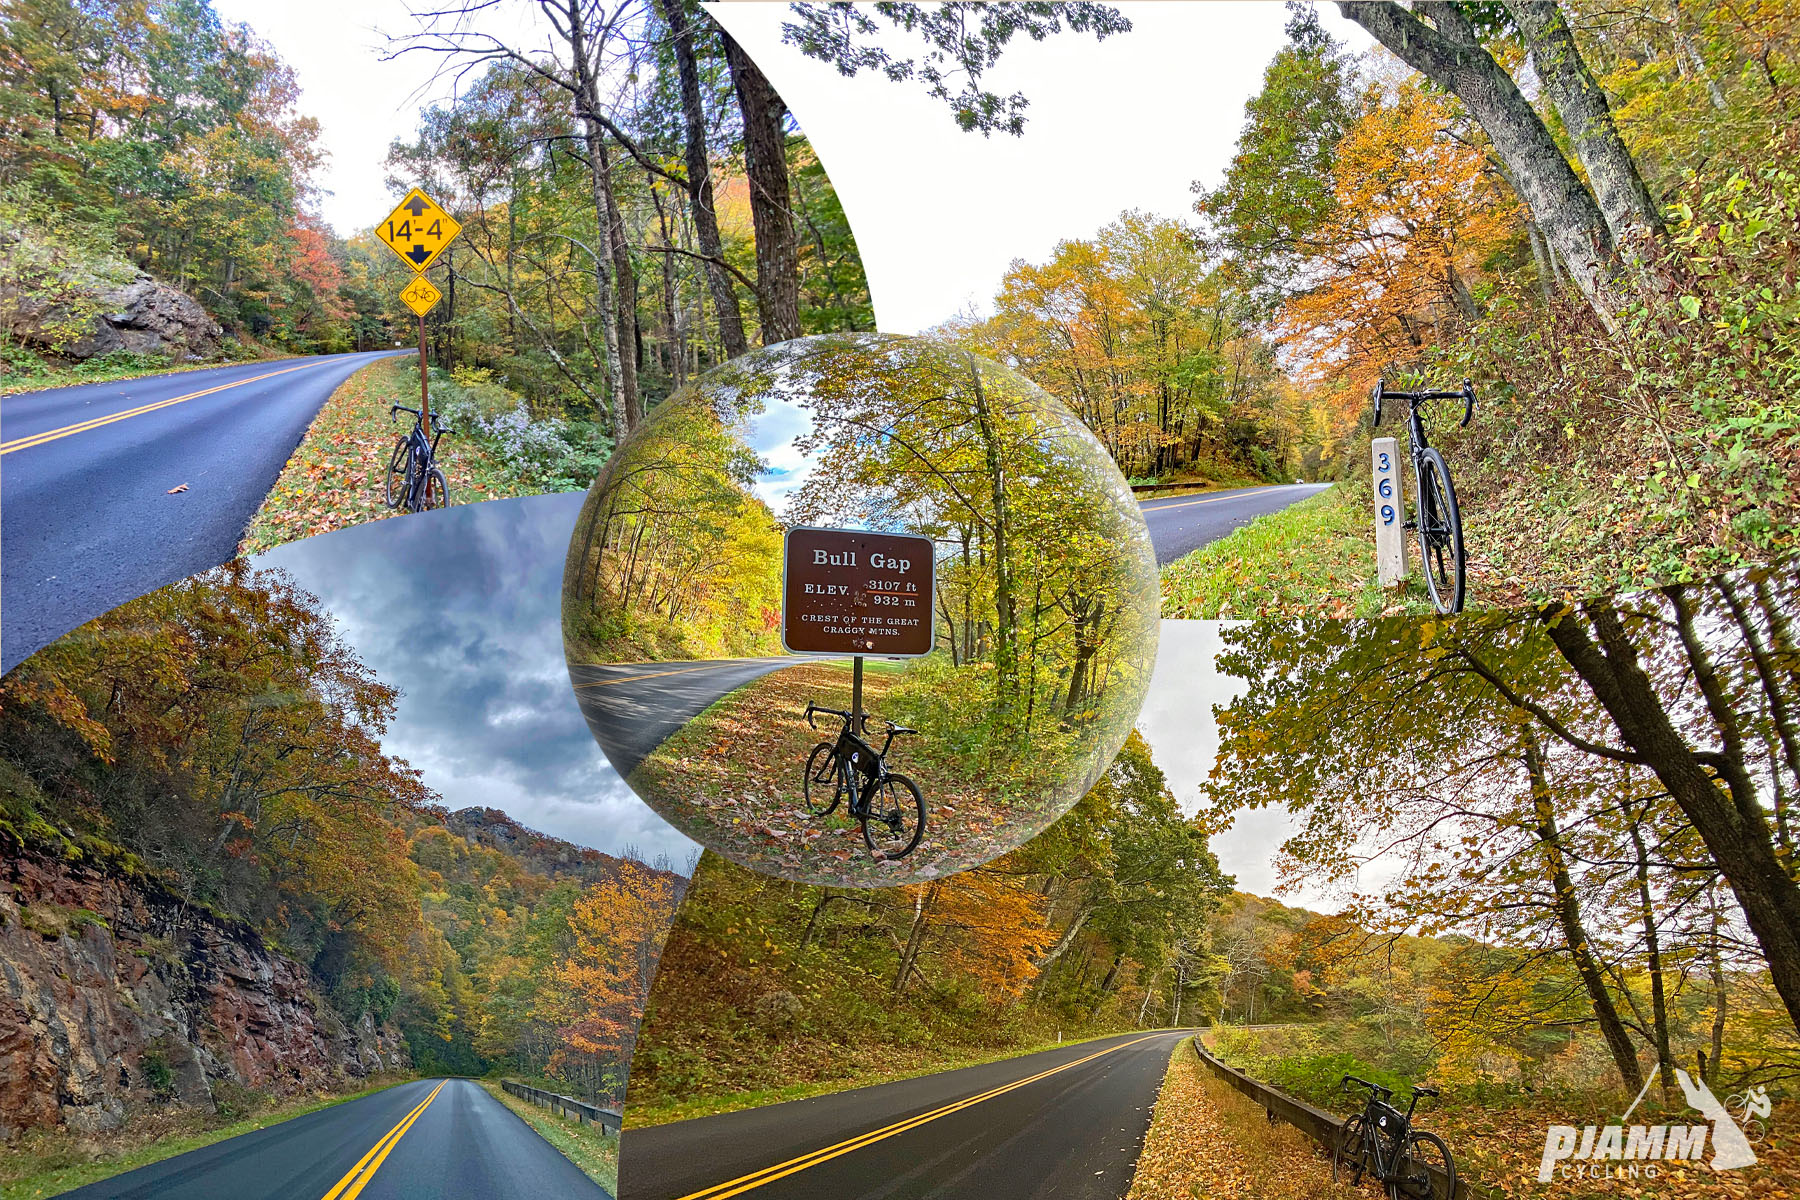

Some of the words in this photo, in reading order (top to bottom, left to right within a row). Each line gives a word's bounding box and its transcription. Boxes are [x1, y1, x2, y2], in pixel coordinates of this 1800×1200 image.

[813, 549, 857, 567] Bull
[870, 553, 911, 574] Gap
[804, 583, 850, 596] ELEV.
[869, 580, 900, 590] 3107
[906, 583, 917, 592] ft
[873, 595, 899, 606] 932
[801, 614, 839, 624] CREST
[843, 616, 857, 625] OF
[861, 616, 883, 625] THE
[887, 618, 920, 626] GREAT
[823, 626, 865, 634] CRAGGY
[868, 628, 900, 636] MTNS.
